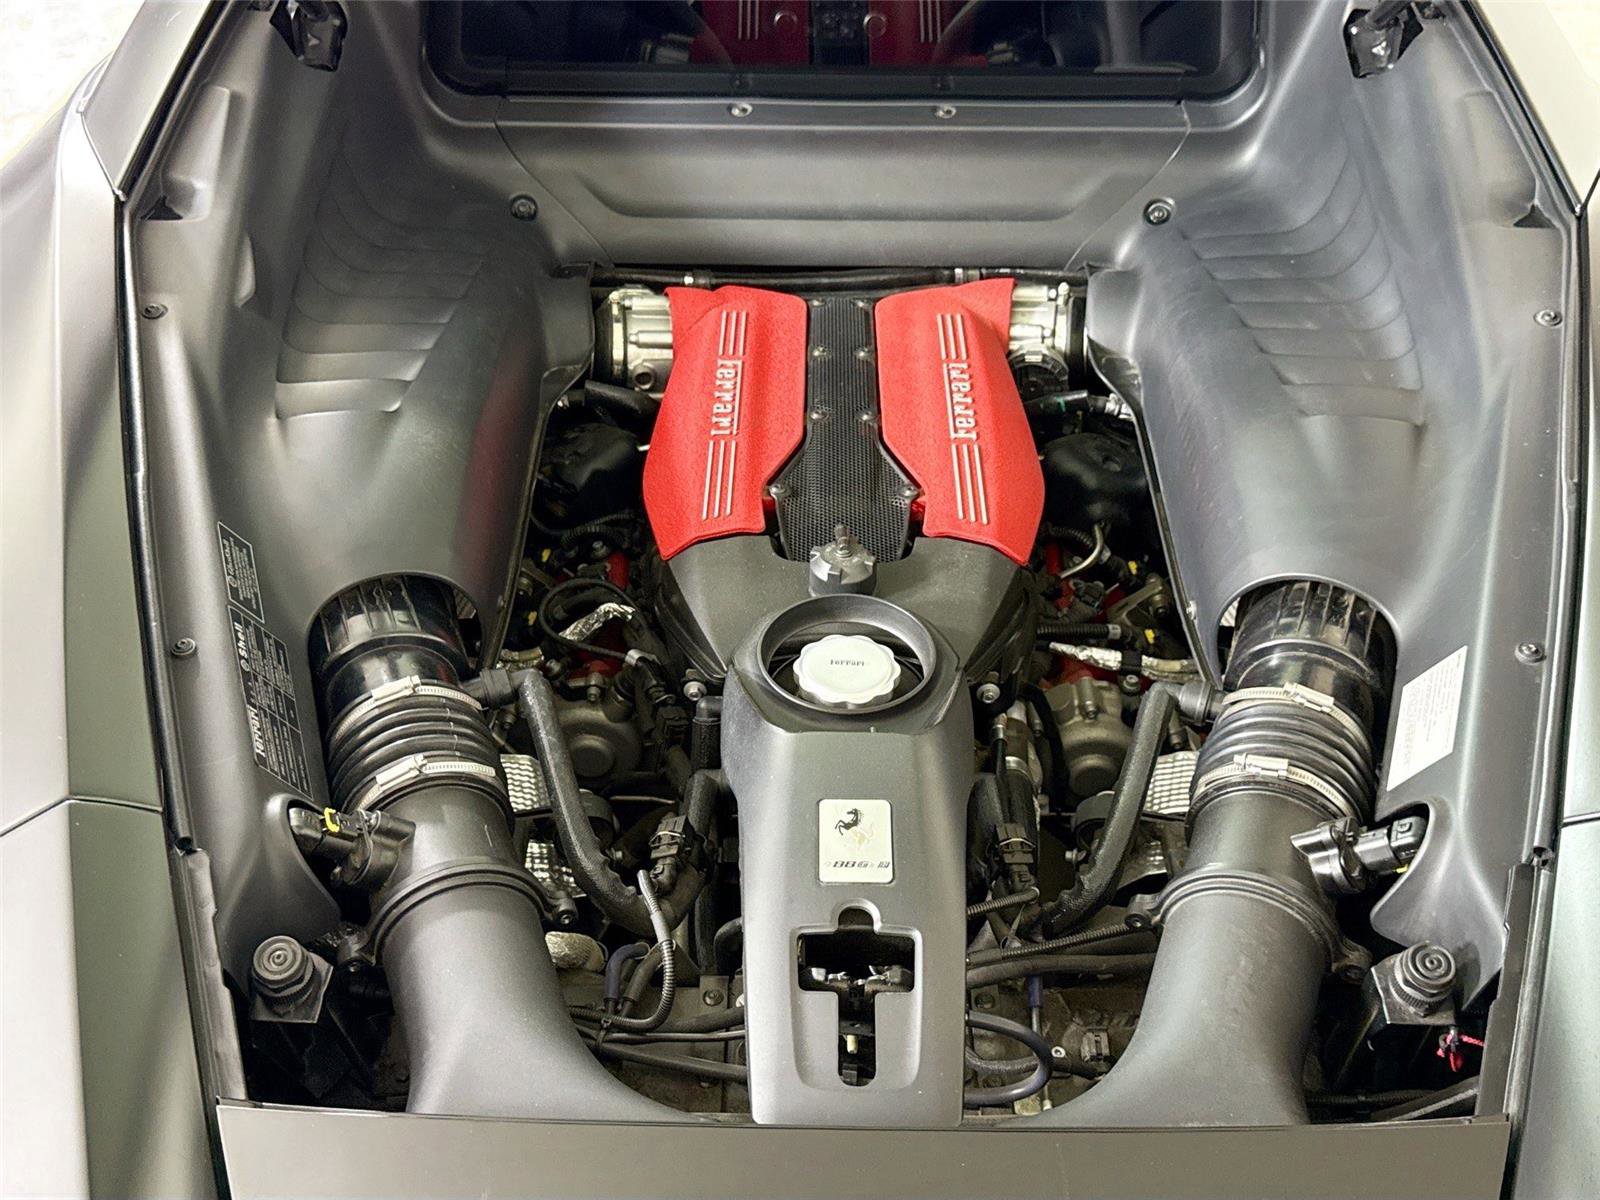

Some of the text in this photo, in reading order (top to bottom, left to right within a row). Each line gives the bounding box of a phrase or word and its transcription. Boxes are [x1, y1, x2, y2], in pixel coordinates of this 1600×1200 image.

[710, 359, 743, 436] Ferrari
[943, 363, 977, 440] Ferrari
[234, 622, 248, 659] Shell
[246, 704, 266, 758] Ferrari
